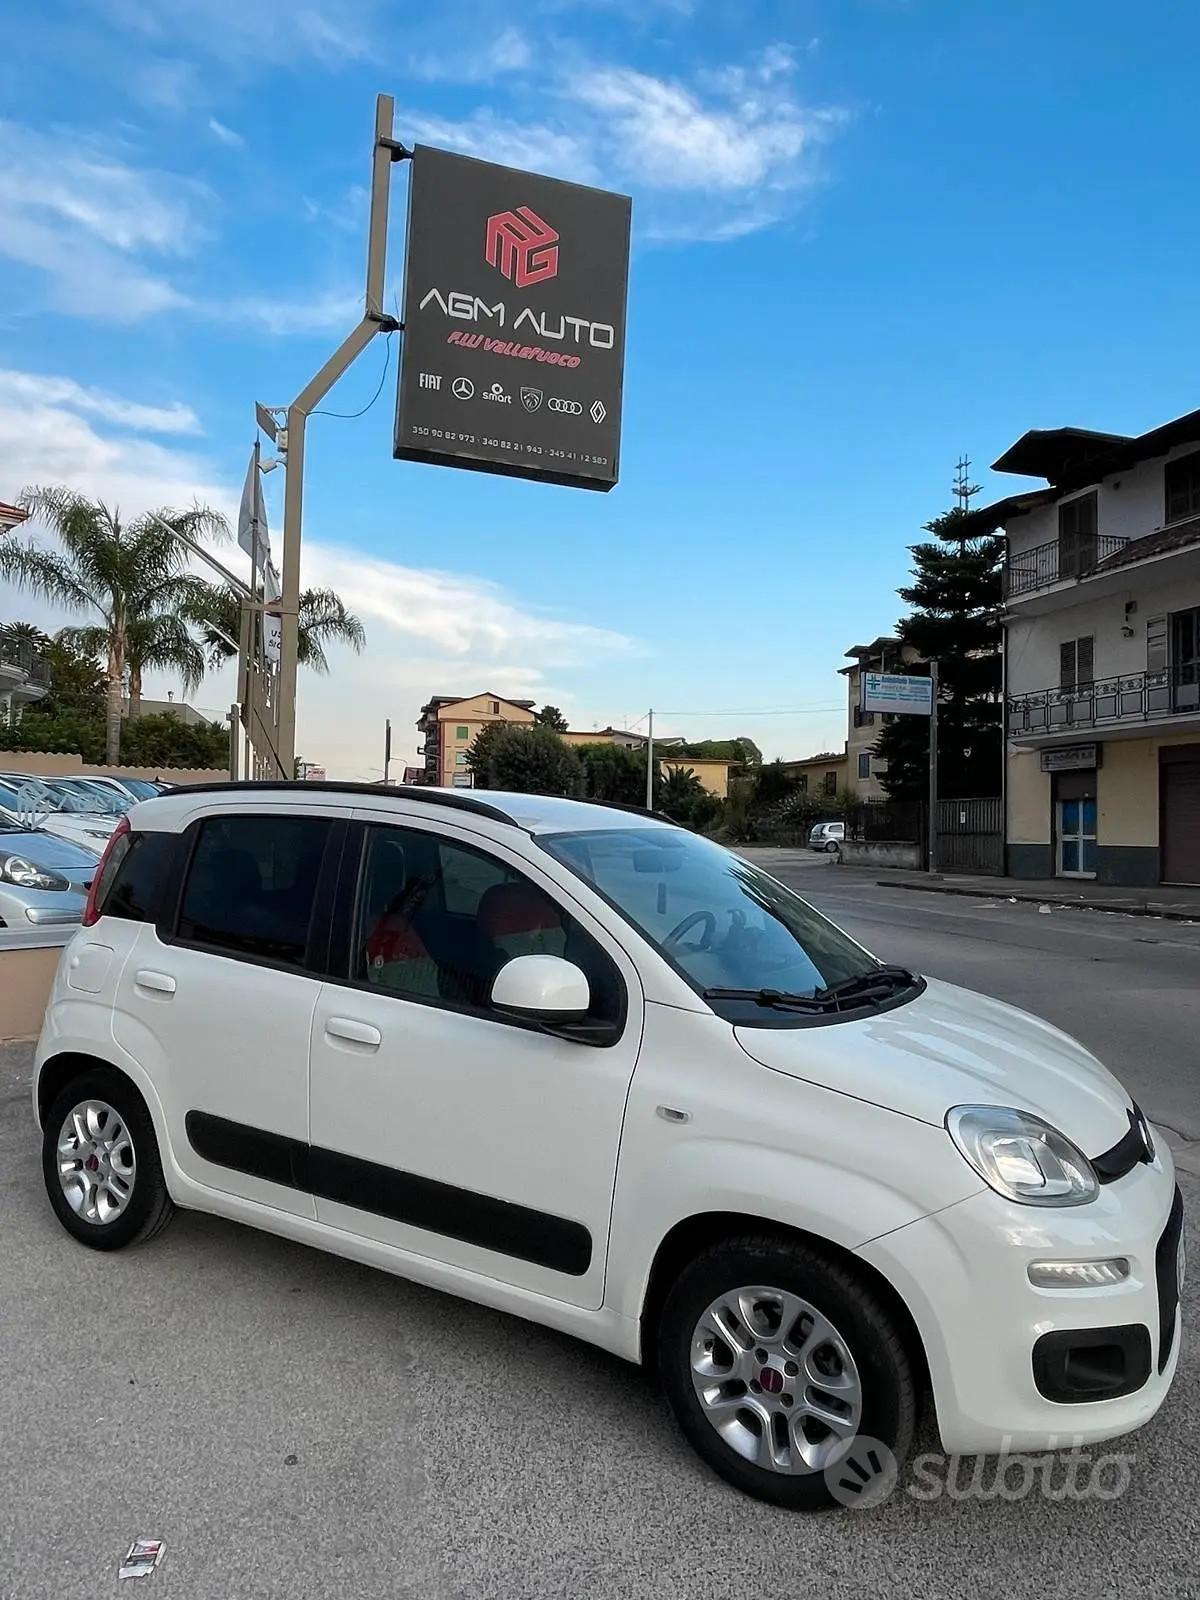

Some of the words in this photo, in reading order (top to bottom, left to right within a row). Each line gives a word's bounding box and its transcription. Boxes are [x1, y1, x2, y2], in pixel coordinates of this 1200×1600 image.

[419, 287, 505, 327] AGM
[513, 307, 615, 350] AUTO
[419, 372, 443, 391] FIAT
[482, 391, 512, 404] smart
[412, 426, 429, 435] 350
[431, 429, 443, 438] 90
[444, 431, 456, 440] 82
[458, 433, 475, 443] 973
[482, 437, 499, 447] 340
[500, 440, 511, 449] 82
[513, 442, 523, 452] 21
[526, 445, 542, 454] 943
[549, 448, 565, 458] 345
[567, 452, 576, 460] 41
[580, 454, 590, 462] 12
[592, 456, 607, 465] 583
